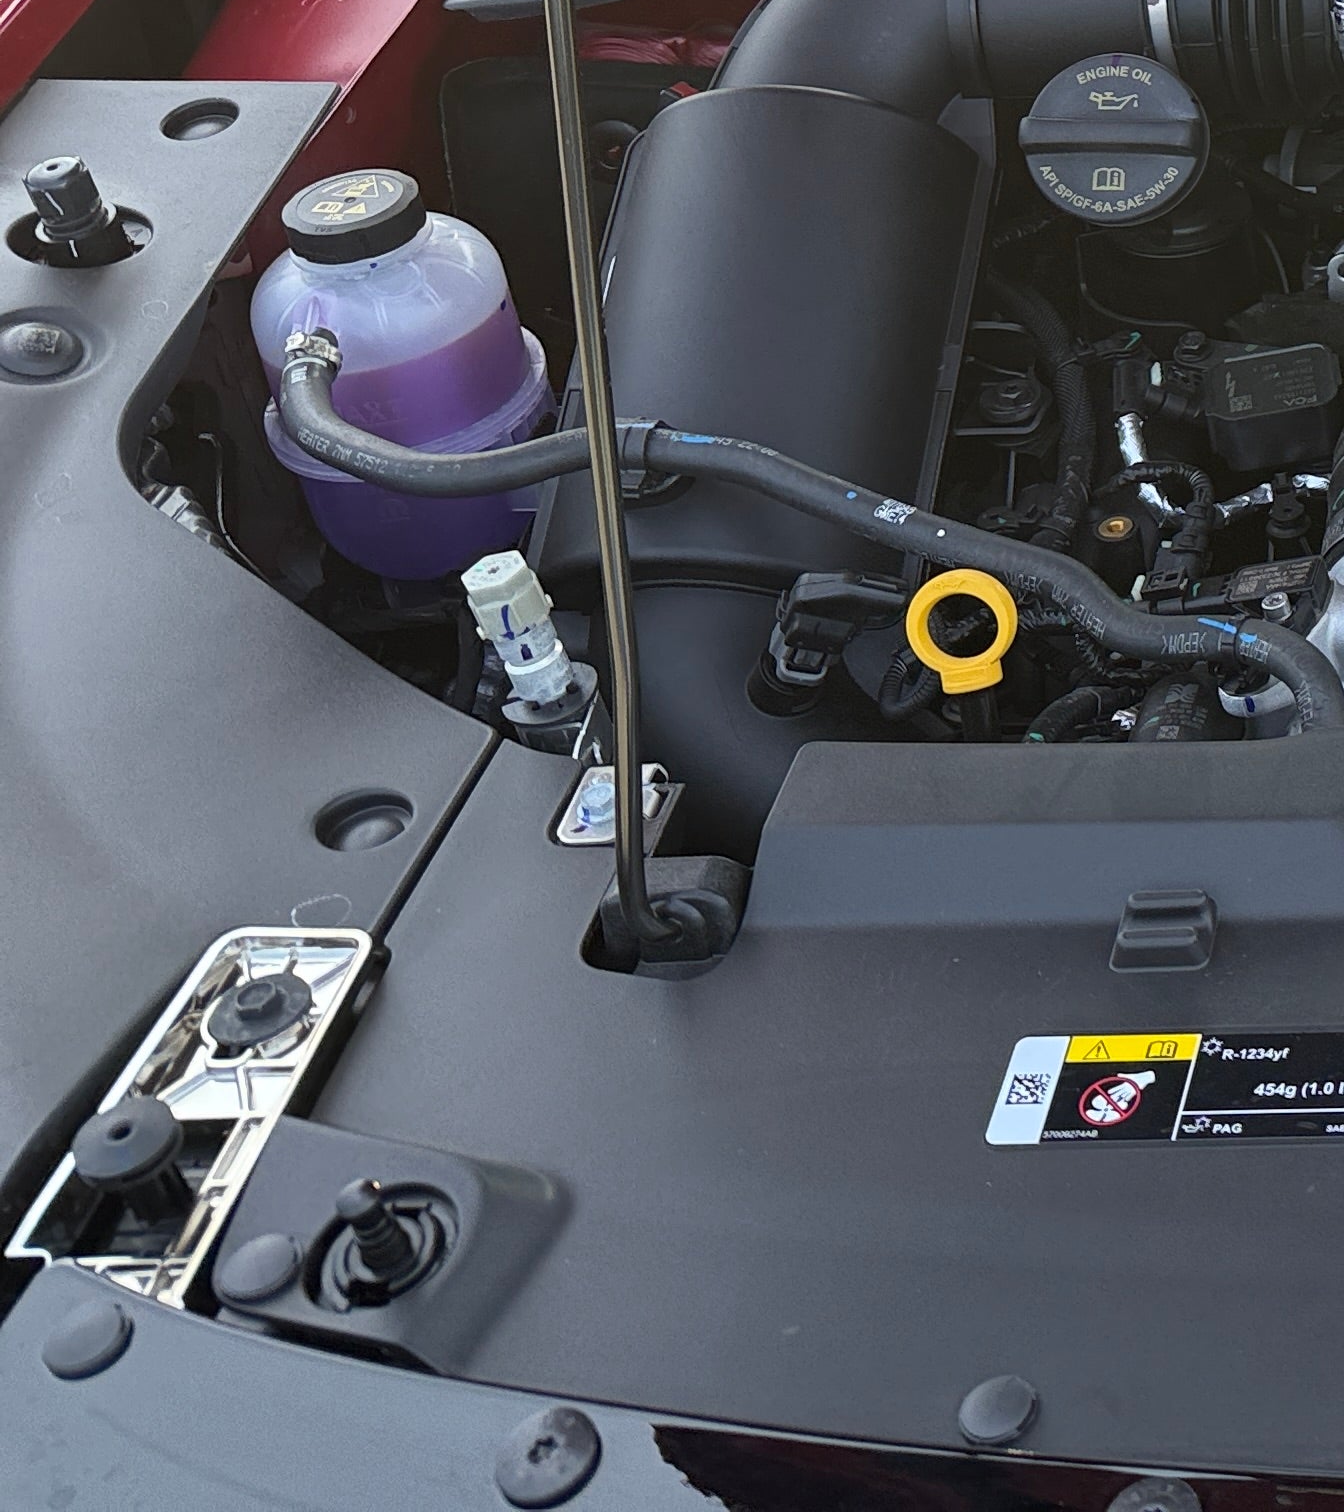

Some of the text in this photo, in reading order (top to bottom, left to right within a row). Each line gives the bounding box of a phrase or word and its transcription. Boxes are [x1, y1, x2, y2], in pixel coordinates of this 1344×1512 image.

[1076, 65, 1153, 86] ENGINE OIL
[1039, 165, 1179, 214] API SP/GF-6A-SAE-5W-30
[297, 427, 331, 455] HEATER
[1069, 602, 1107, 641] HEATER
[1221, 1047, 1290, 1063] R-1234yf
[1253, 1081, 1296, 1098] 454g
[1300, 1081, 1335, 1098] (1.0
[1212, 1122, 1243, 1135] PAG
